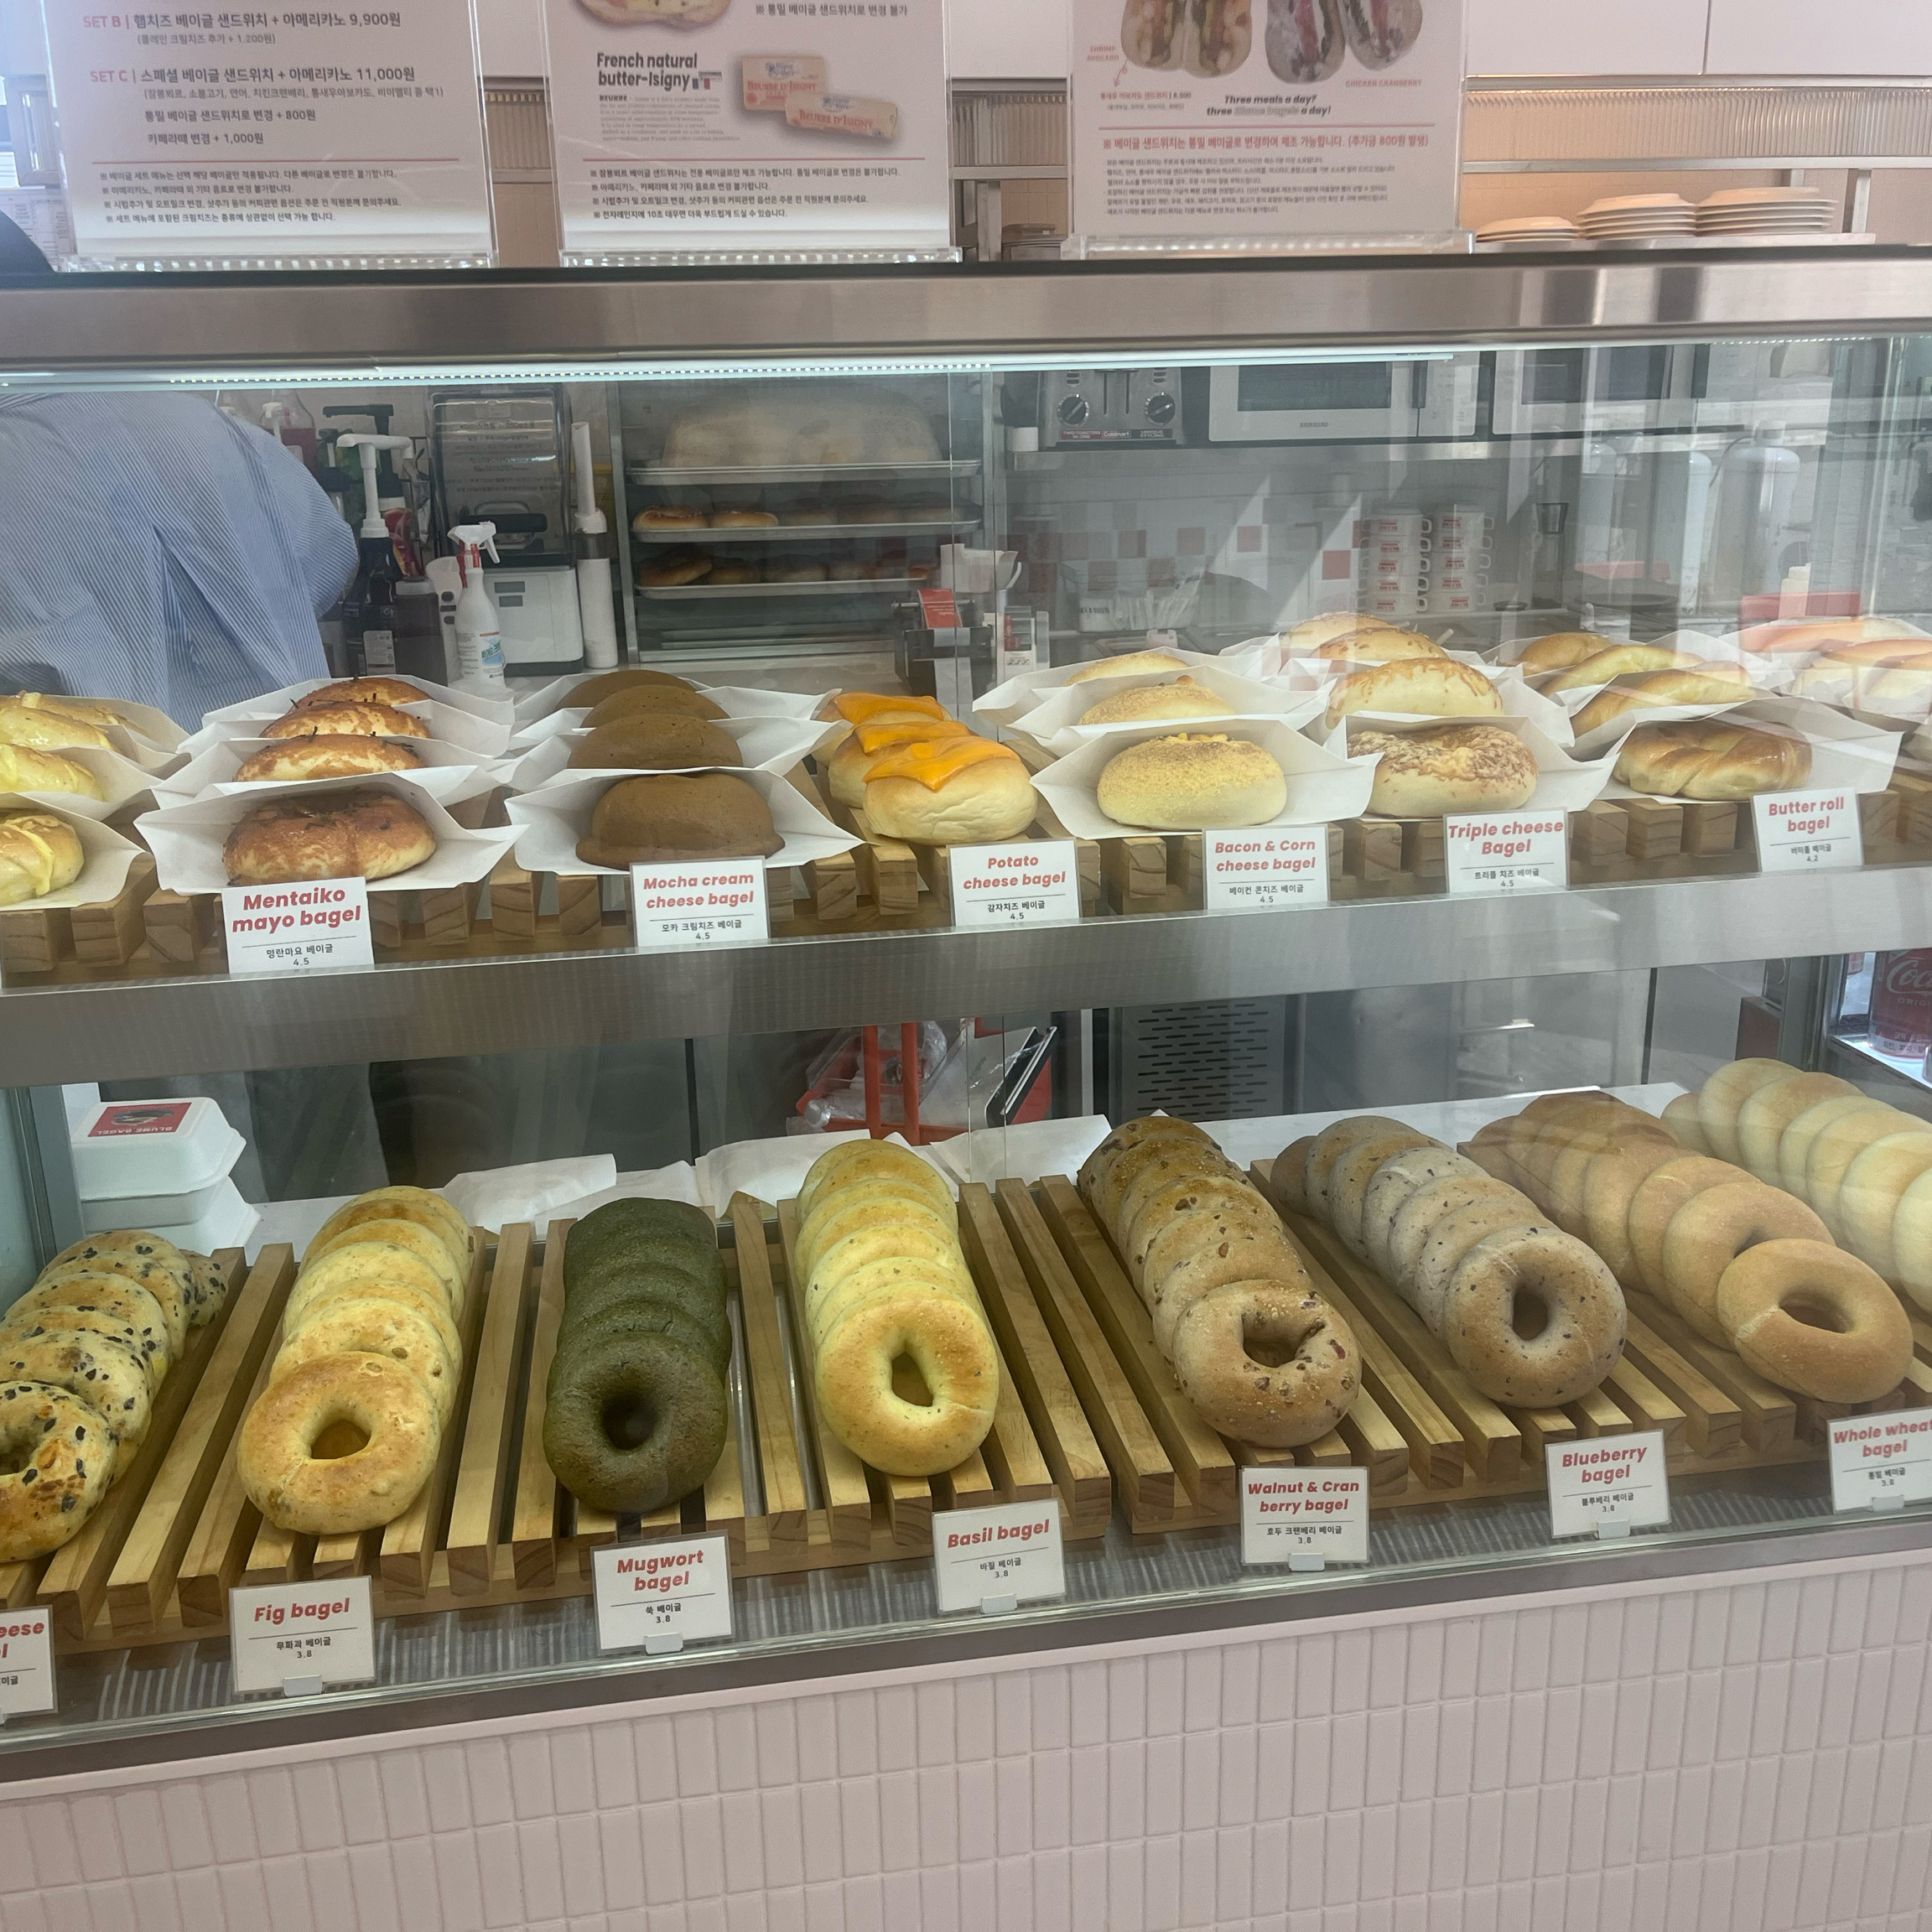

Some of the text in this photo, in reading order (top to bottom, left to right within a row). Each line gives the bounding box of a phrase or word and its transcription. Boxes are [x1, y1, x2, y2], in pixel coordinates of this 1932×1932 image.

[788, 4, 817, 16] 베이글
[819, 4, 865, 17] 샌드위치로
[868, 4, 886, 17] 변경
[84, 13, 401, 29] SET B 햄치즈 베이글 샌드위치 아메리카노 9,900원
[597, 52, 698, 69] French natural
[90, 67, 415, 83] SET C 스페셜 베이글 샌드위치 아메리카노 11,000원
[599, 70, 691, 92] butter-Isigny
[1224, 95, 1252, 105] Three
[1254, 95, 1283, 104] meals
[1293, 95, 1317, 106] day?
[145, 109, 316, 122] 통밀 베이글 샌드위치로 변경 800원
[1207, 107, 1233, 116] three
[1309, 106, 1332, 117] day!
[148, 132, 264, 145] 카페라떼 변경 1,000원
[1114, 138, 1140, 150] 베이글
[1143, 137, 1186, 150] 샌드위치는
[1208, 137, 1242, 149] 베이글로
[1244, 136, 1278, 149] 변경하여
[1379, 135, 1405, 148] 800원
[1768, 797, 1844, 816] Butter roll
[1448, 821, 1564, 842] Triple cheese
[1788, 816, 1830, 834] bagel
[1215, 840, 1316, 854] Bacon & Corn
[1481, 839, 1531, 858] Bagel
[988, 855, 1039, 869] Potato
[1216, 857, 1316, 873] cheese bagel
[963, 871, 1066, 890] cheese bagel
[1474, 868, 1540, 880] 트리플 치즈 베이글
[643, 874, 754, 890] Mocha cream
[1229, 884, 1304, 896] 베이컨 콘치즈 베이글
[243, 887, 345, 911] Mentaiko
[646, 891, 754, 909] cheese bagel
[987, 901, 1045, 913] 감자치즈 베이글
[232, 906, 361, 934] mayo bagel
[682, 922, 714, 932] 크림치즈
[718, 920, 742, 929] 베이글
[267, 943, 333, 958] 명란마요 베이글
[293, 958, 309, 966] 4.5
[1834, 1419, 1932, 1444] Whole wheat
[1562, 1447, 1648, 1467] Blueberry
[1862, 1440, 1908, 1459] bagel
[1581, 1464, 1630, 1484] bagel
[1868, 1467, 1906, 1480] 통밀 베이글
[1248, 1481, 1359, 1494] Walnut & Cran
[1882, 1478, 1894, 1487] 3.8
[1259, 1498, 1349, 1514] berry bagel
[1581, 1493, 1634, 1506] 블루베리 베이글
[948, 1519, 1050, 1548] Basil bagel
[1285, 1526, 1317, 1535] 크랜베리
[1319, 1525, 1343, 1535] 베이글
[617, 1550, 704, 1575] Mugwort
[979, 1557, 1021, 1571] 바질 베이글
[634, 1571, 689, 1592] bagel
[995, 1570, 1009, 1578] 3.8
[254, 1597, 351, 1625] Fig bagel
[646, 1602, 682, 1615] 쑥 베이글
[656, 1615, 671, 1623] 3.8
[276, 1637, 331, 1650] 무화과 베이글
[297, 1650, 312, 1659] 3.8
[0, 1675, 18, 1686] 이글
